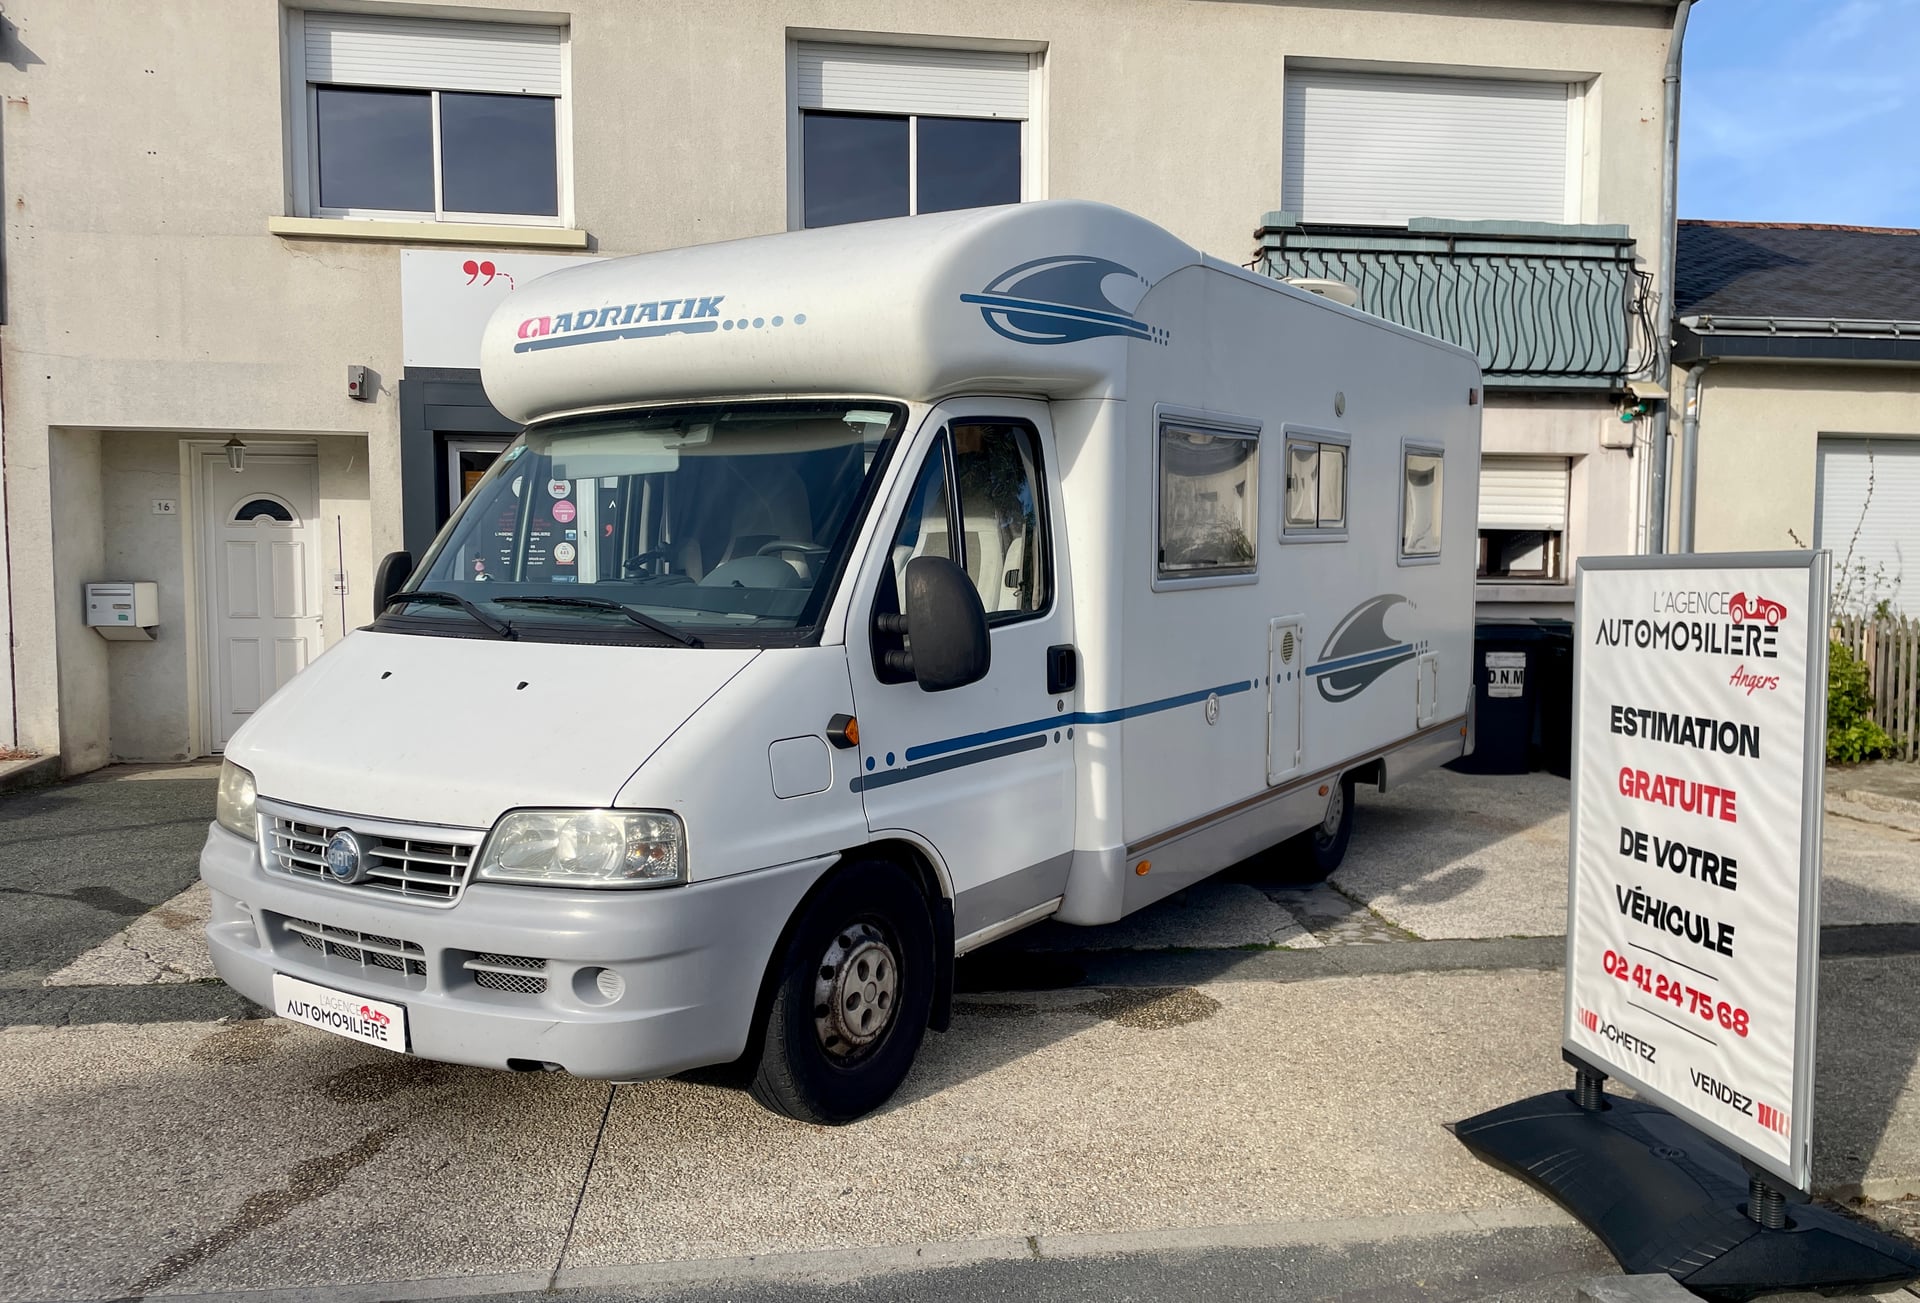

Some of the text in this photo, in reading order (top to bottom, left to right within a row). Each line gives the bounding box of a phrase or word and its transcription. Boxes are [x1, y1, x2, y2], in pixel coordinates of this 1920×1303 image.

[551, 295, 726, 334] ADRIATIK
[158, 502, 170, 511] 16
[1653, 591, 1730, 615] L'AGENCE
[1729, 664, 1779, 696] Angers
[1610, 704, 1760, 759] ESTIMATION
[1618, 766, 1737, 823] GRATUITE
[1619, 826, 1737, 891] DE VOTRE
[1616, 884, 1735, 958] VÉHICULE
[320, 994, 361, 1017] L'AGENCE
[1603, 950, 1750, 1038] 02 41 24 75 68
[1600, 1021, 1656, 1064] ACHETEZ
[1690, 1067, 1753, 1117] VENDEZ
